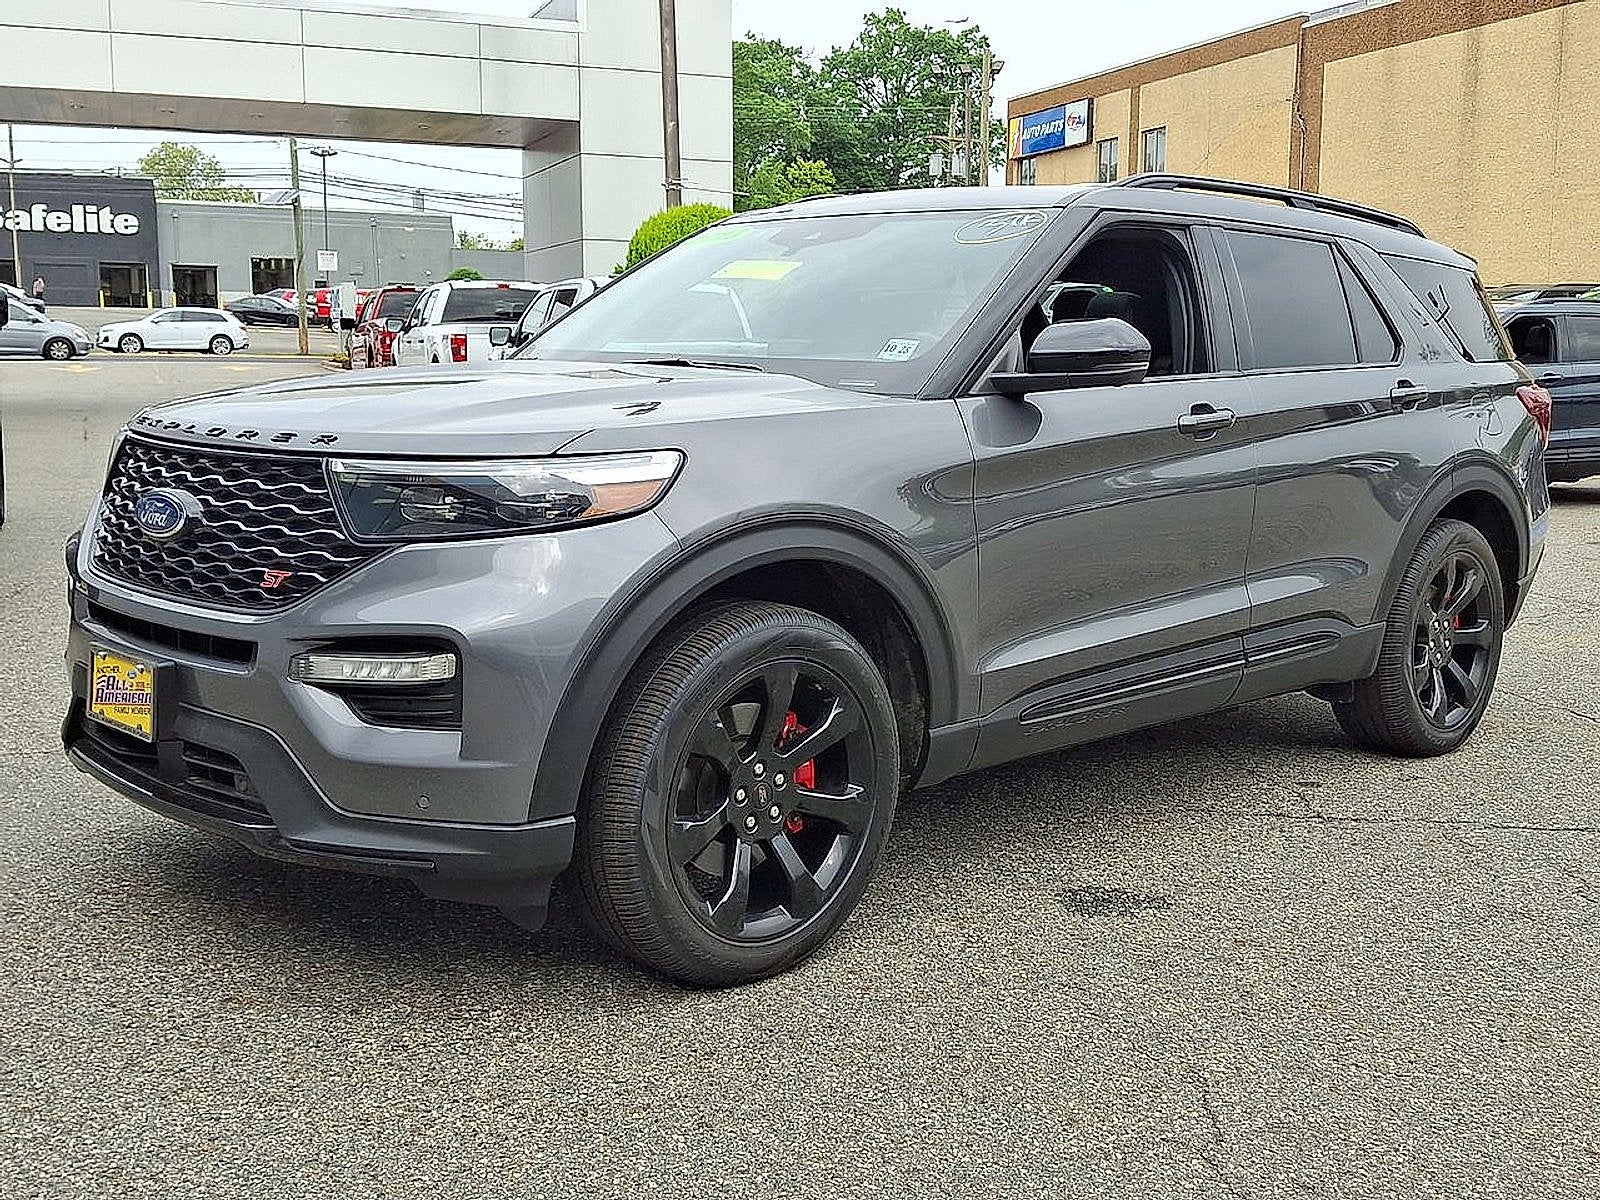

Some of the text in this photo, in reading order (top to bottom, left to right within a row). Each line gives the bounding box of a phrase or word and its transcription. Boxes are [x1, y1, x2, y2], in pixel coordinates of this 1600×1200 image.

[136, 416, 339, 445] EXPLORER
[141, 500, 171, 527] Ford
[260, 570, 291, 588] ST
